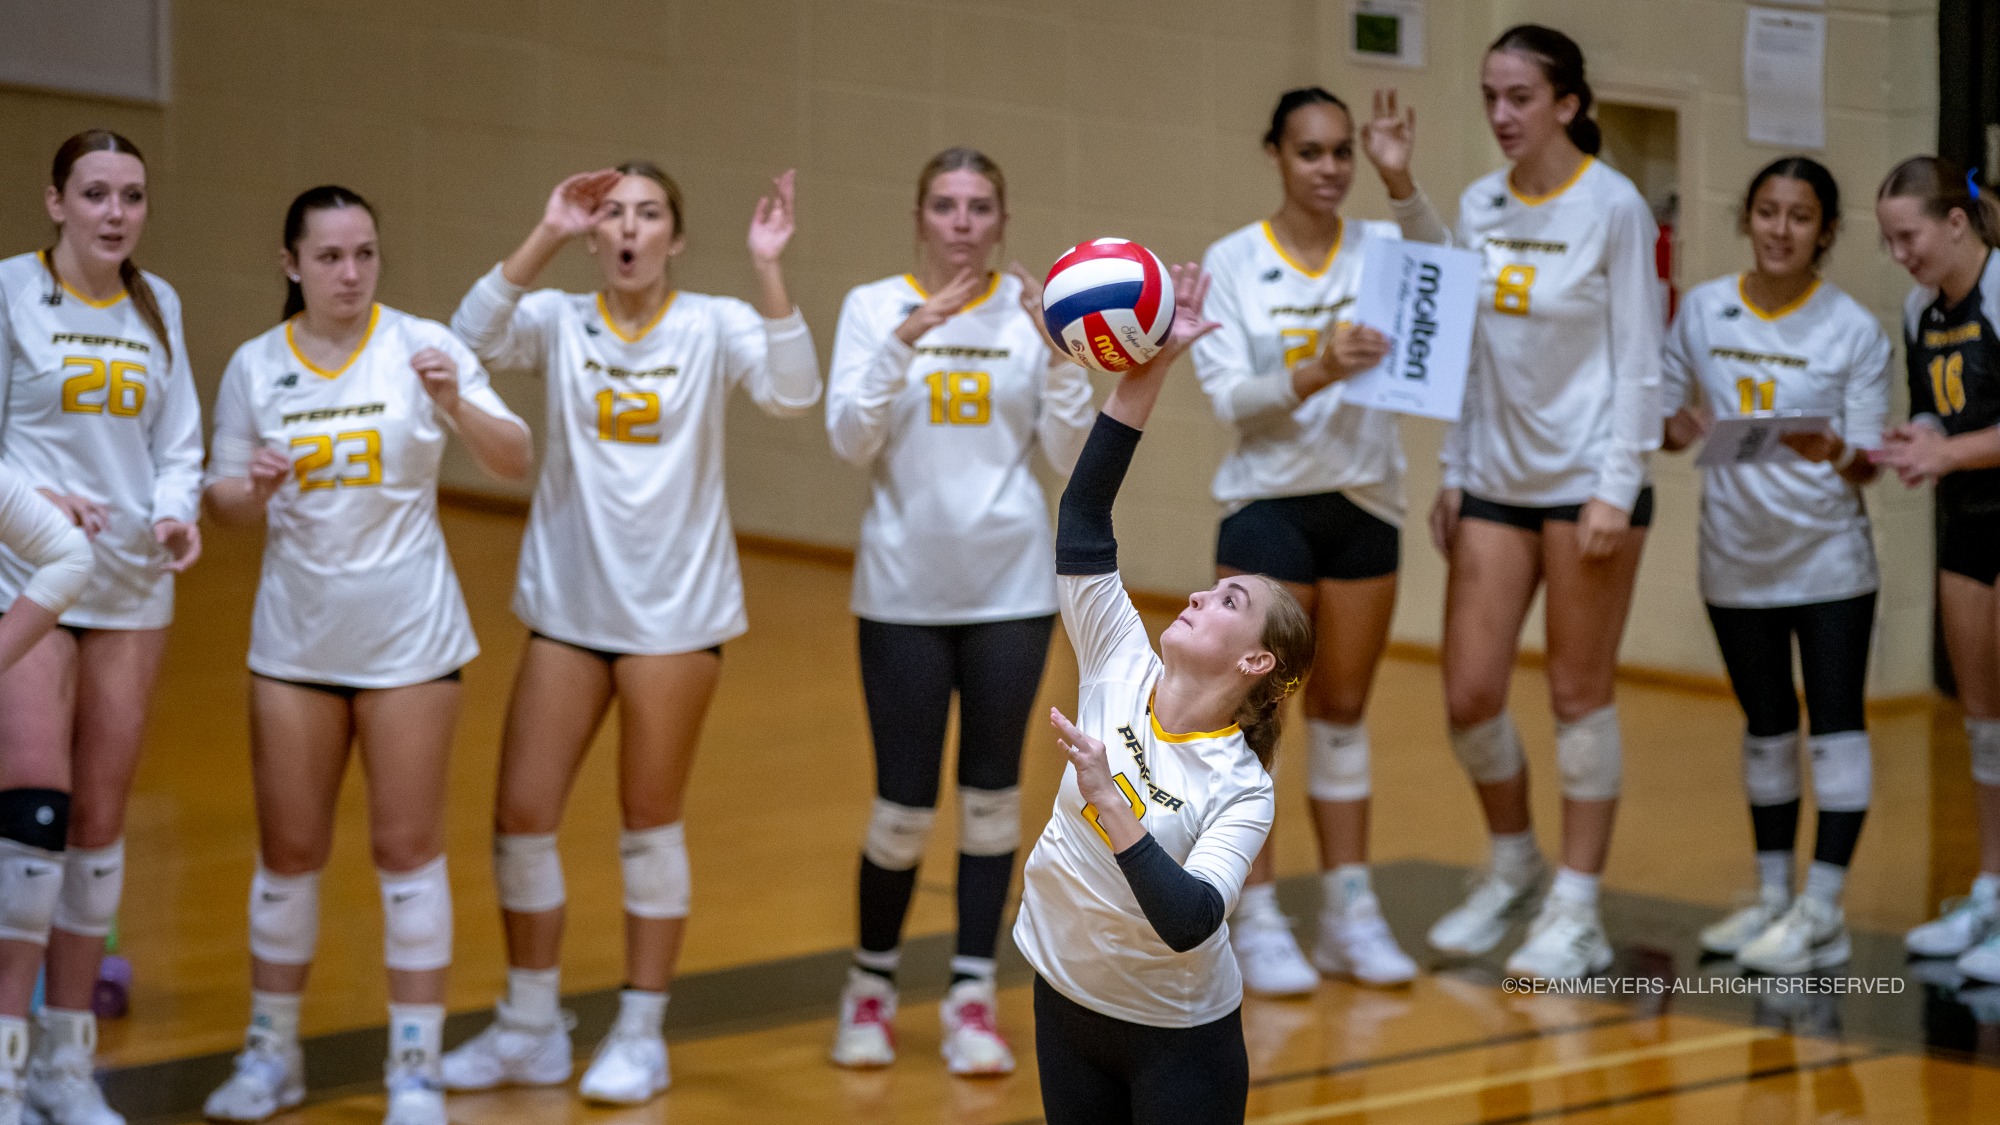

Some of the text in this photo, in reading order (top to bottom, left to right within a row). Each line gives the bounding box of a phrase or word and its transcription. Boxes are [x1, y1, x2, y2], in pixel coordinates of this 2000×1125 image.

[1494, 264, 1537, 317] 8
[52, 333, 150, 353] PFEIFFER
[1405, 261, 1441, 381] molten
[1094, 334, 1131, 371] molt
[62, 356, 147, 417] 26
[924, 370, 991, 426] 18
[1736, 376, 1776, 416] 11
[594, 387, 661, 445] 12
[289, 429, 383, 492] 23
